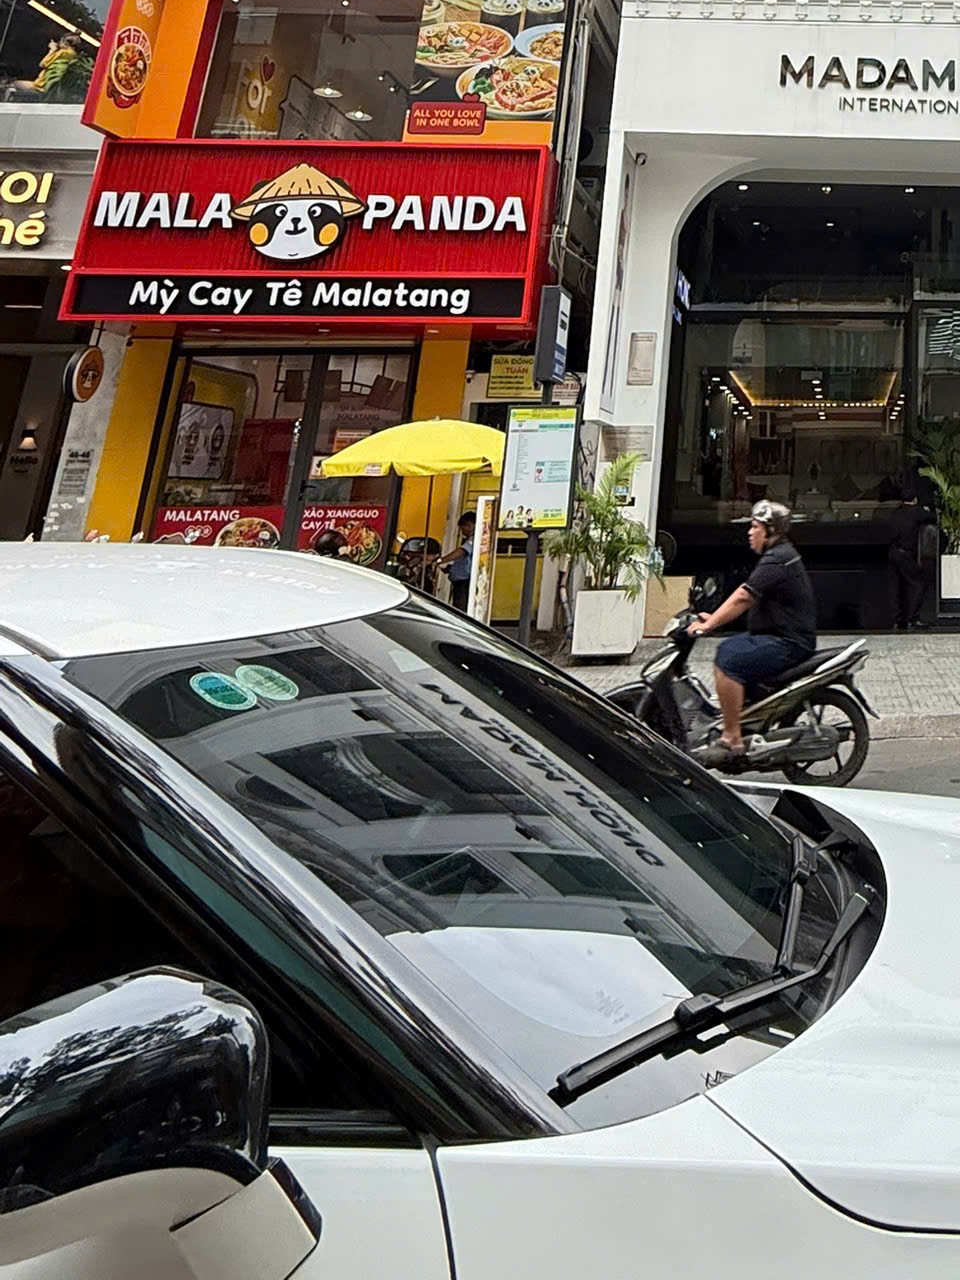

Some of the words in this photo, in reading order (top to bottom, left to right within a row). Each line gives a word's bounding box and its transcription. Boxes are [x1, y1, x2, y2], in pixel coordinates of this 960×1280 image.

[779, 54, 956, 92] MADAM
[413, 109, 433, 118] ALL
[434, 109, 458, 118] YOU
[459, 108, 483, 119] LOVE
[416, 118, 427, 127] IN
[428, 118, 451, 128] ONE
[453, 117, 480, 128] BOWL
[0, 171, 54, 204] OI
[94, 191, 233, 228] MALA
[362, 194, 527, 232] PANDA
[129, 279, 179, 314] Mỳ
[188, 283, 253, 314] Cay
[266, 279, 303, 307] Tê
[312, 280, 471, 315] Malatang
[164, 509, 241, 523] MALATANG
[326, 508, 379, 519] XIANGGUO
[301, 520, 322, 531] CAY
